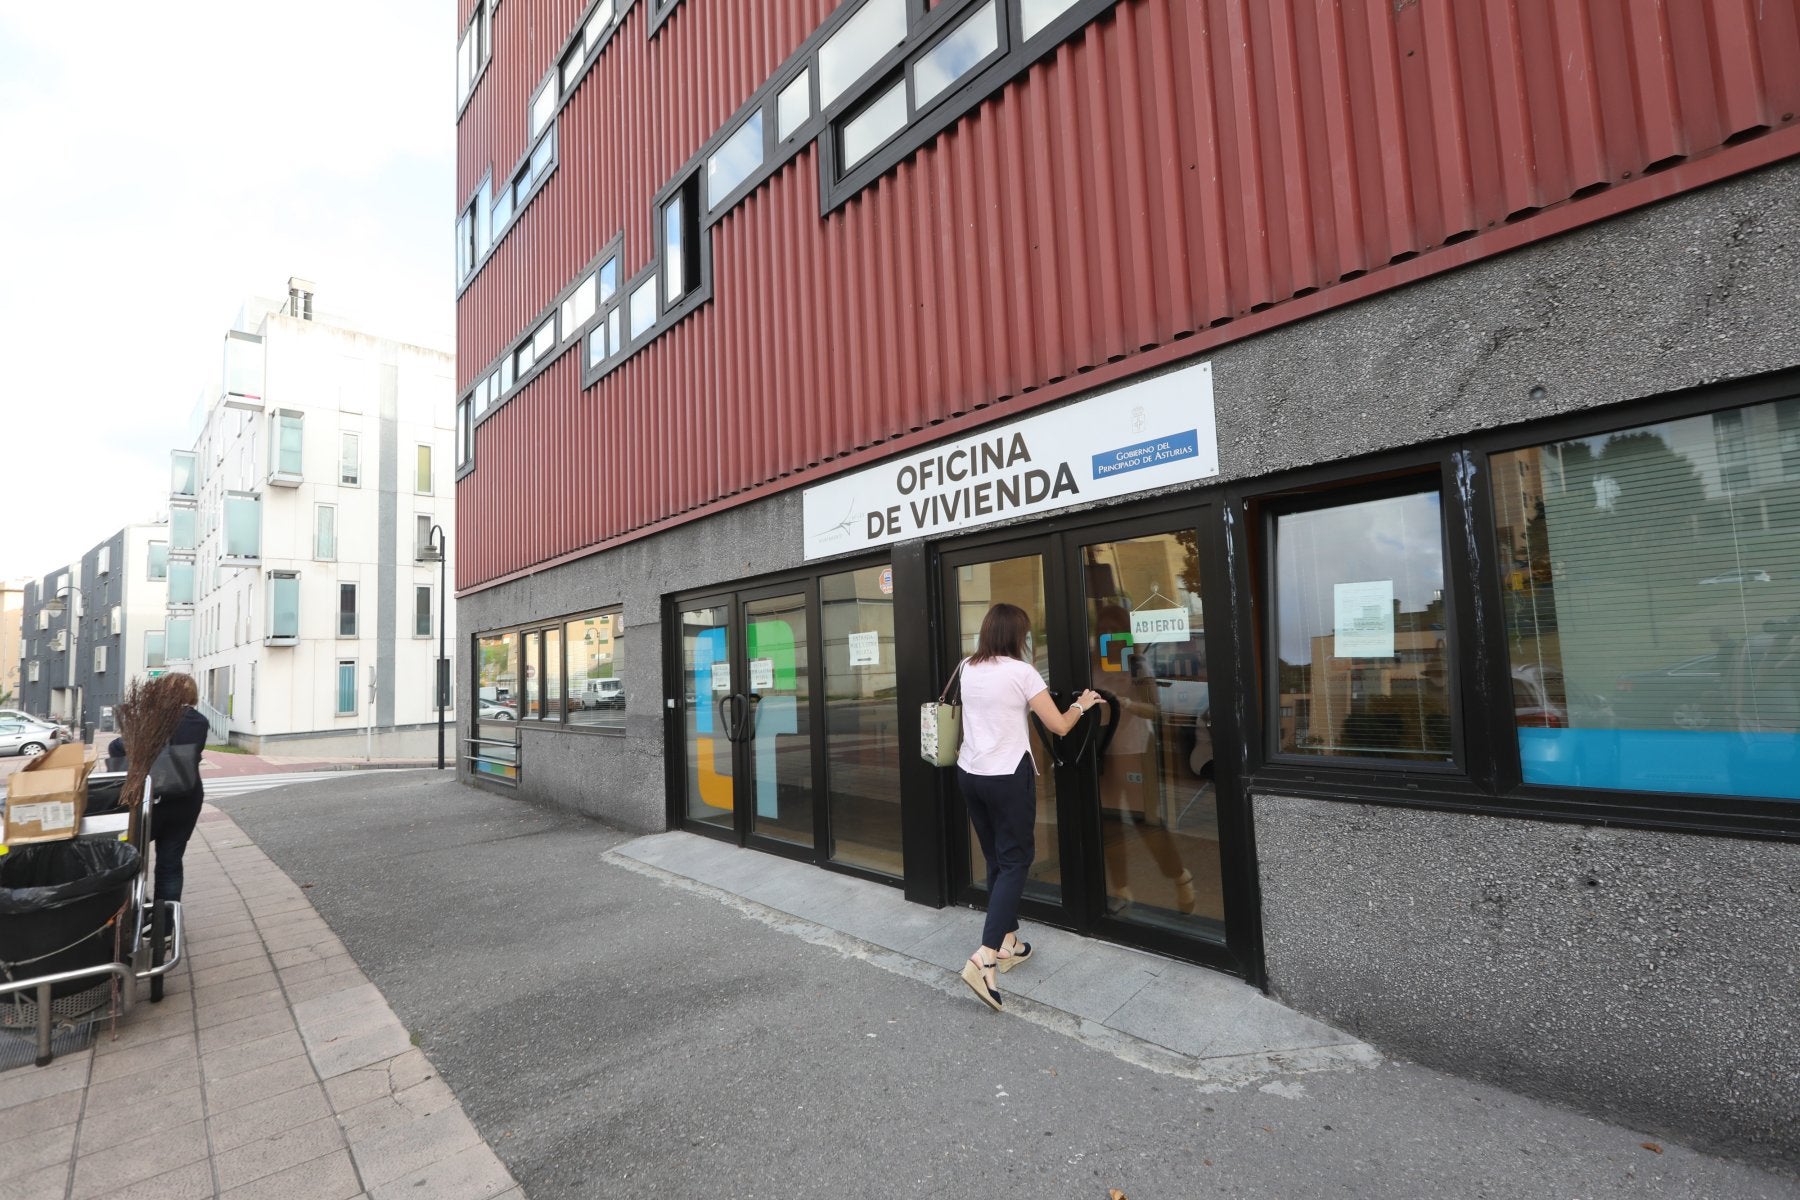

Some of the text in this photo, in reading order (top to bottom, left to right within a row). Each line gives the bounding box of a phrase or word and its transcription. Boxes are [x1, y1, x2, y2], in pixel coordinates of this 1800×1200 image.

[897, 432, 1031, 495] OFICINA
[1098, 445, 1193, 475] PRINCIPADO DE ASTURIAS
[1116, 442, 1170, 461] GOBIERNO DEL
[867, 461, 1080, 540] DE VIVIENDA
[1135, 619, 1185, 633] ABIERTO
